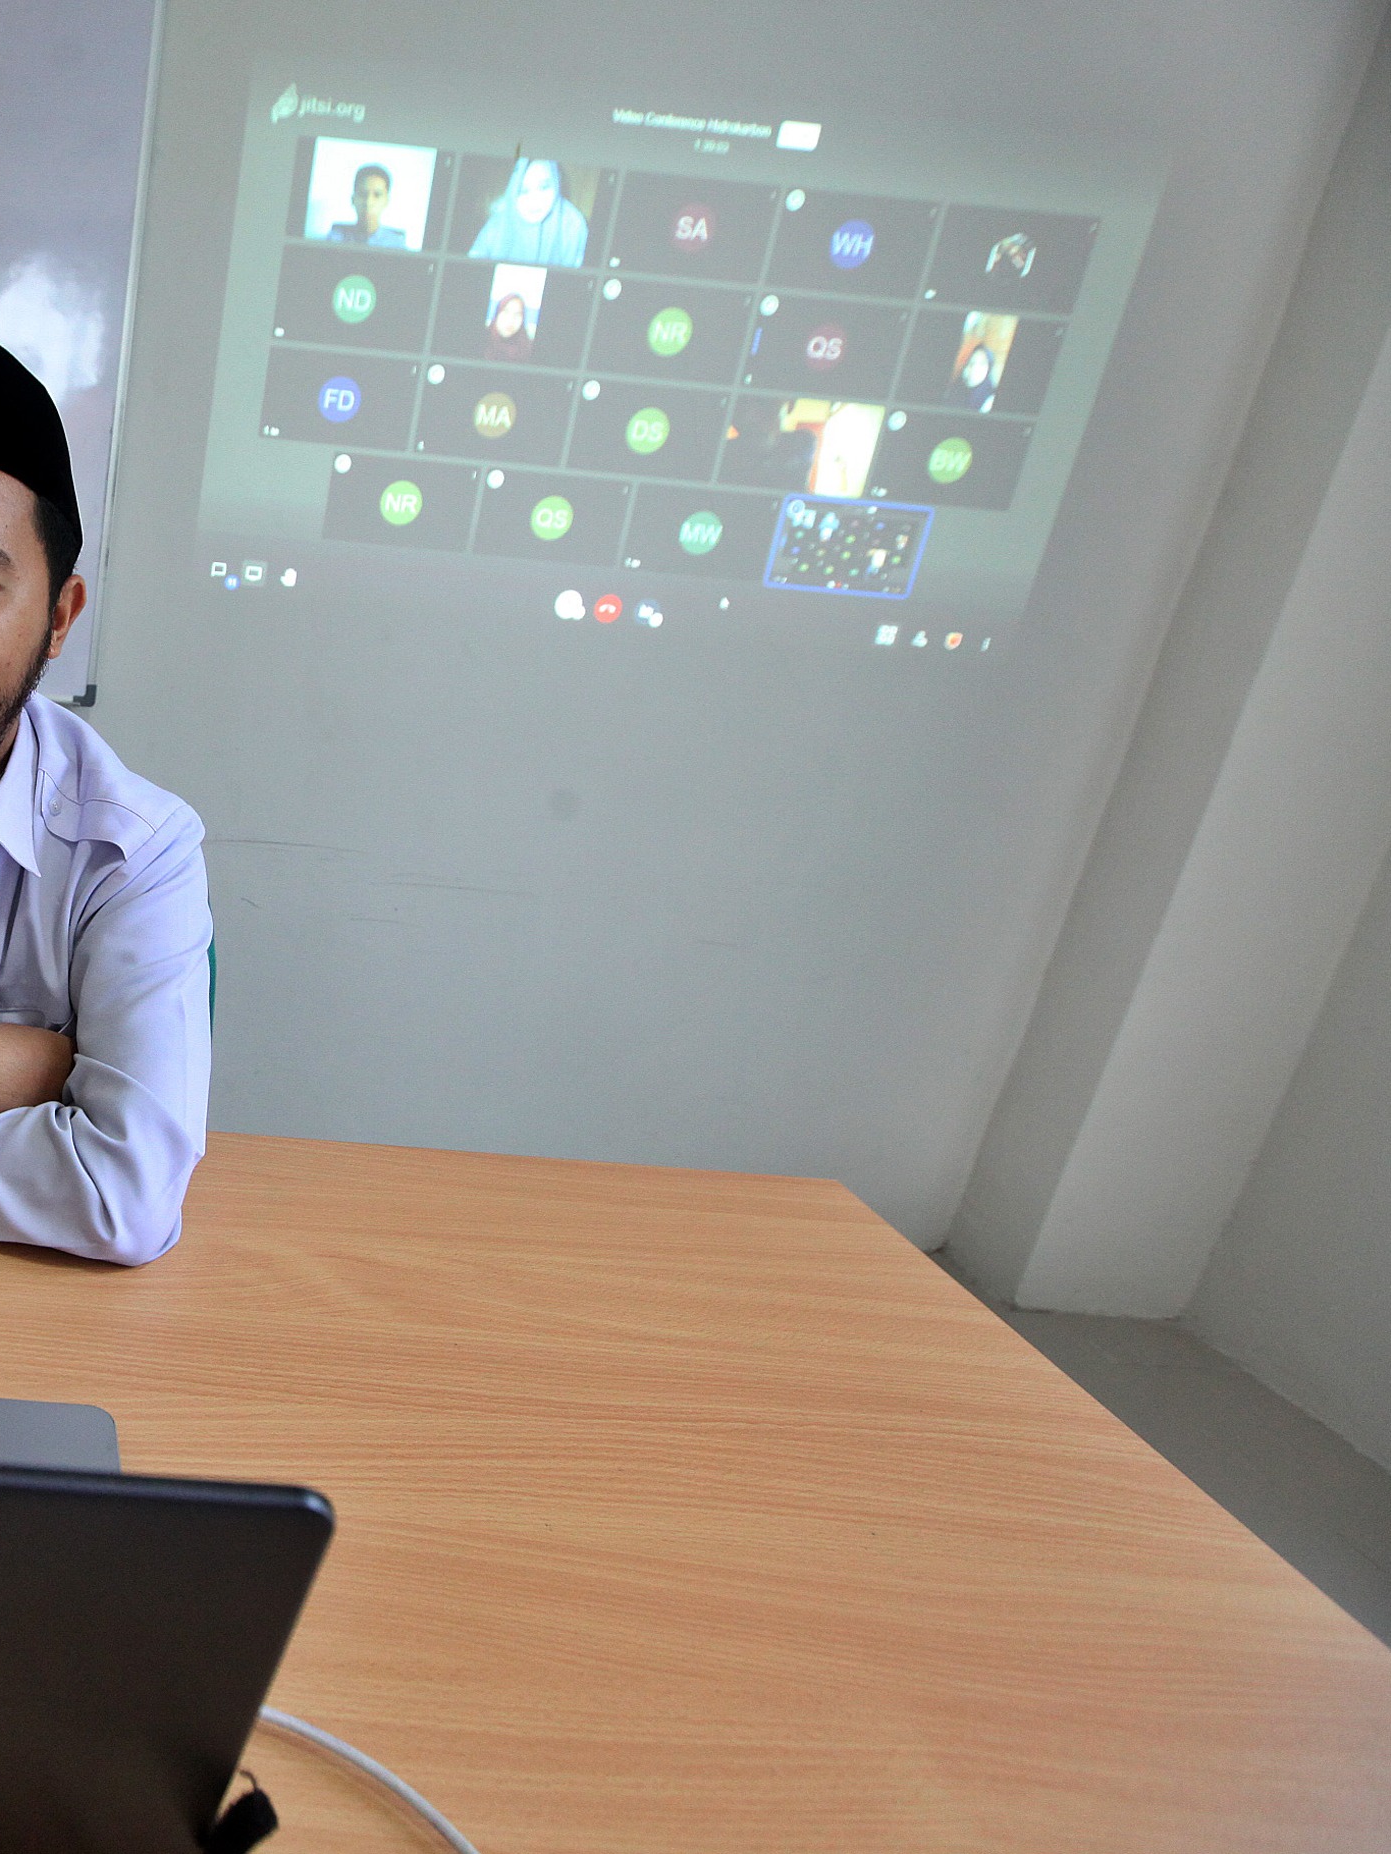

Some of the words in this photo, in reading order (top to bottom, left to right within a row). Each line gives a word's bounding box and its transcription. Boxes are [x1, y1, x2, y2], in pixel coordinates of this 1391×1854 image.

[297, 96, 365, 122] jitsi.org
[675, 215, 708, 242] SA
[831, 231, 874, 258] WH
[337, 287, 372, 312] ND
[653, 320, 688, 344] NR
[323, 386, 355, 412] FD
[474, 403, 512, 428] MA
[631, 419, 664, 443] DS
[384, 491, 418, 515] NR
[535, 506, 569, 531] QS
[679, 521, 723, 546] MW
